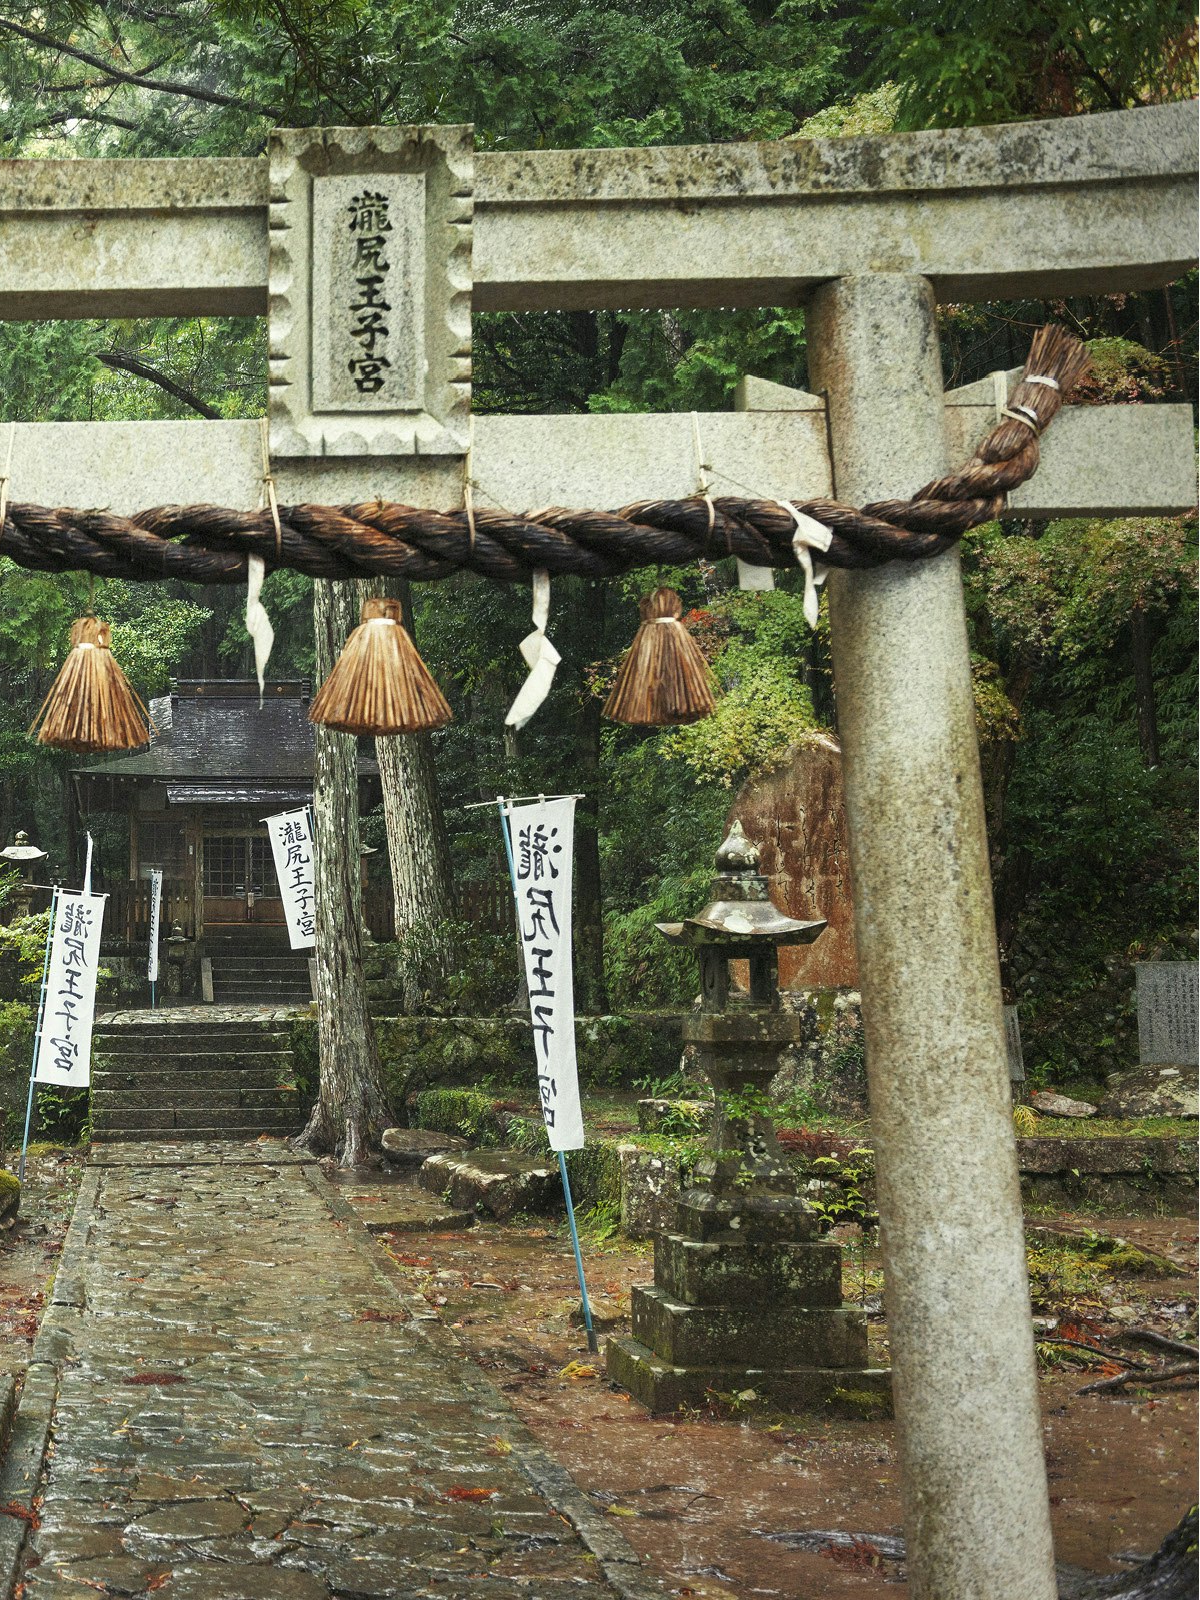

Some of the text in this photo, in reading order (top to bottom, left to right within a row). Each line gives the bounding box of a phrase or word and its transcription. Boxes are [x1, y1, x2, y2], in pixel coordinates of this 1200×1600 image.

[347, 189, 393, 394] 瀧尻王子宮
[278, 821, 315, 938] 瀧尻王子宮
